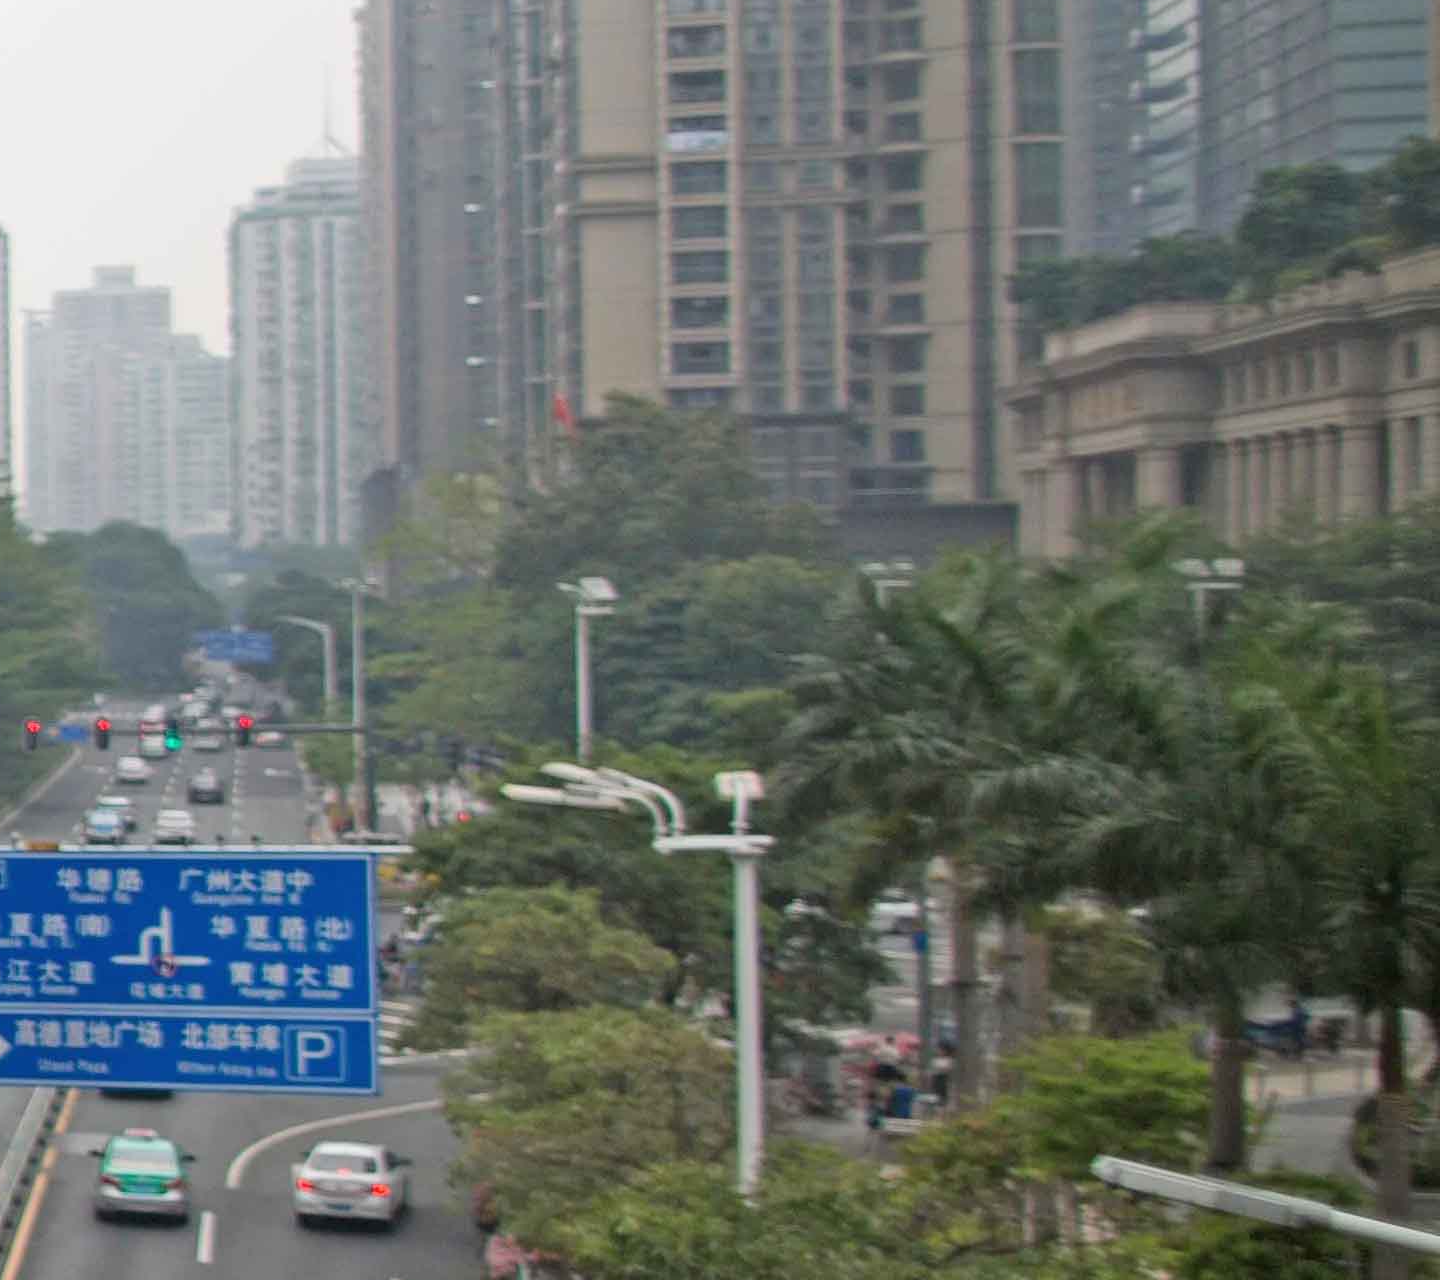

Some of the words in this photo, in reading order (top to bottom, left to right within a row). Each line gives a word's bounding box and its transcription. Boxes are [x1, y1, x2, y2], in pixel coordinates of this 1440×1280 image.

[178, 868, 315, 894] 广州大道中
[295, 1031, 336, 1075] P
